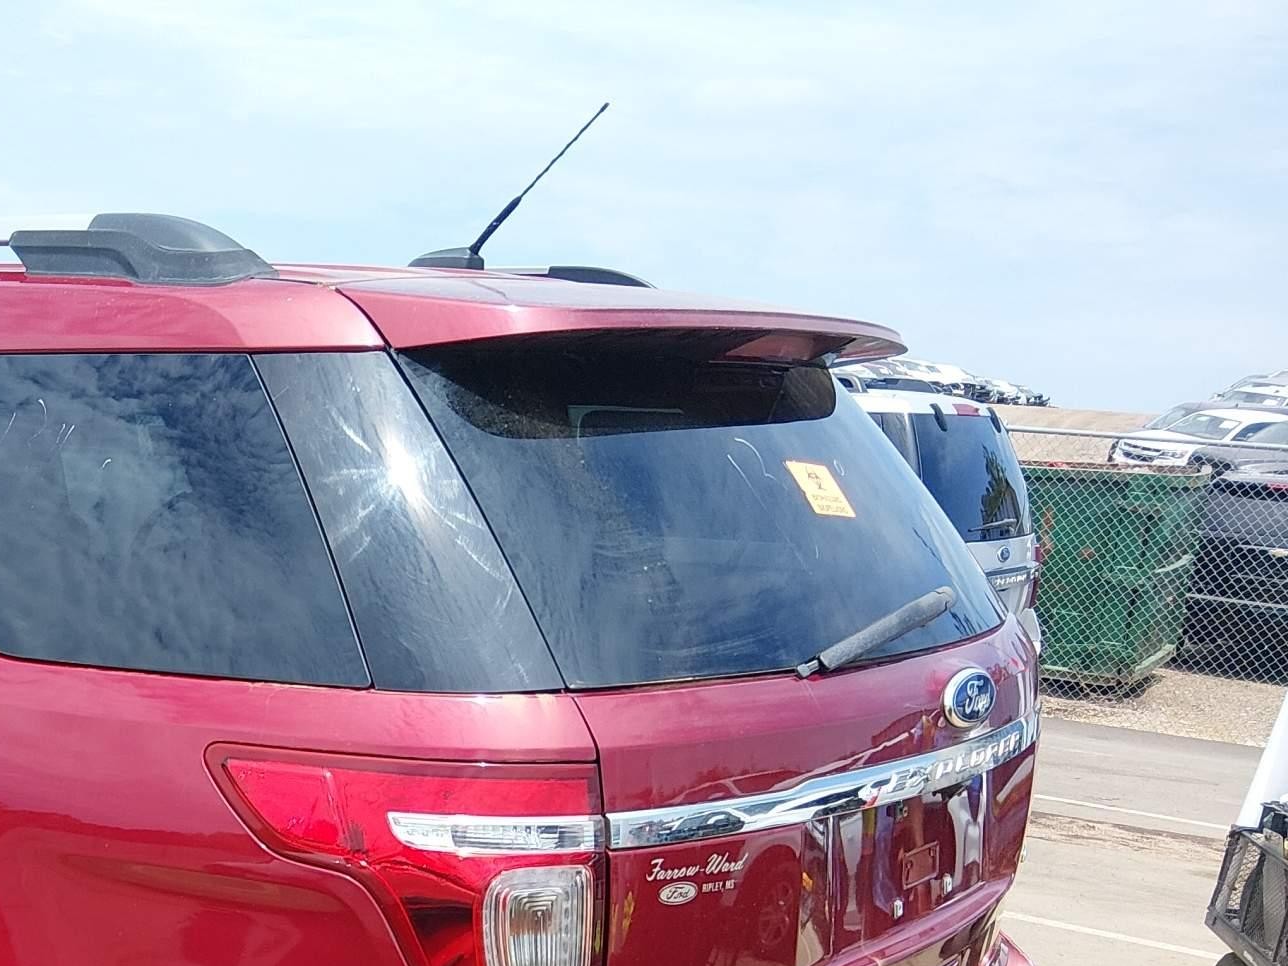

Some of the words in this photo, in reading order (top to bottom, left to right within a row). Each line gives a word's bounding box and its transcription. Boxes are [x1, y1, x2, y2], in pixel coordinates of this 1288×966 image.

[885, 731, 1021, 794] EXPLORER
[646, 852, 748, 881] Farrow-Ward
[702, 881, 724, 893] RIPLEY,
